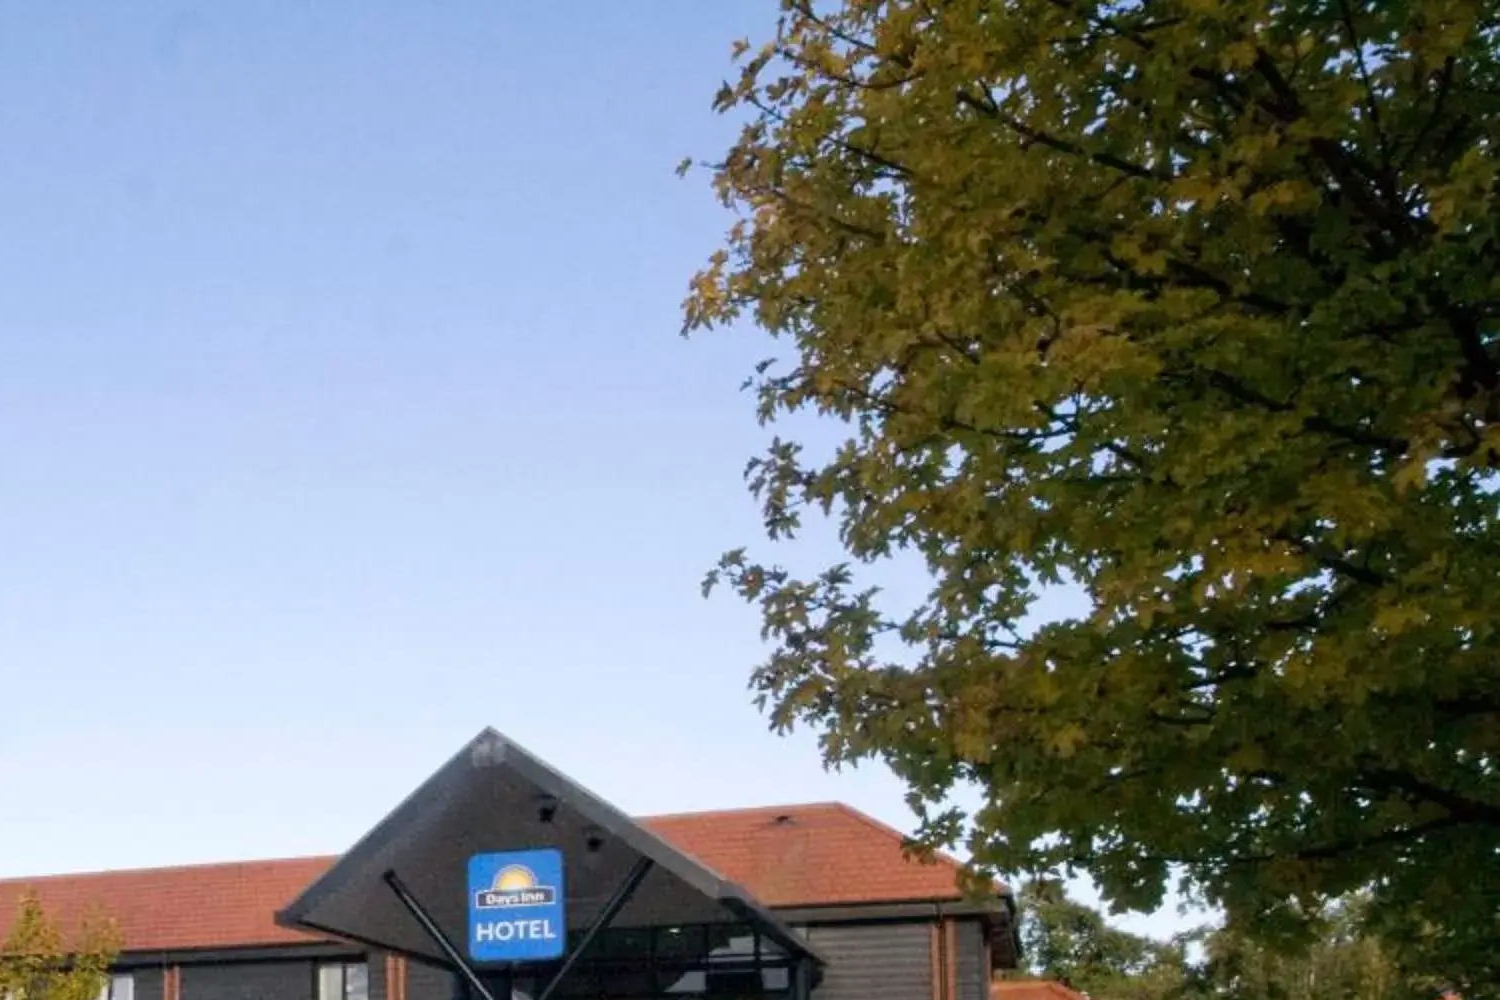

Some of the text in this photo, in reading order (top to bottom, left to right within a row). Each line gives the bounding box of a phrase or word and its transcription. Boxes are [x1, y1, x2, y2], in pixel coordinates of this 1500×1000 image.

[485, 891, 545, 906] Days Inn
[476, 919, 557, 942] HOTEL
